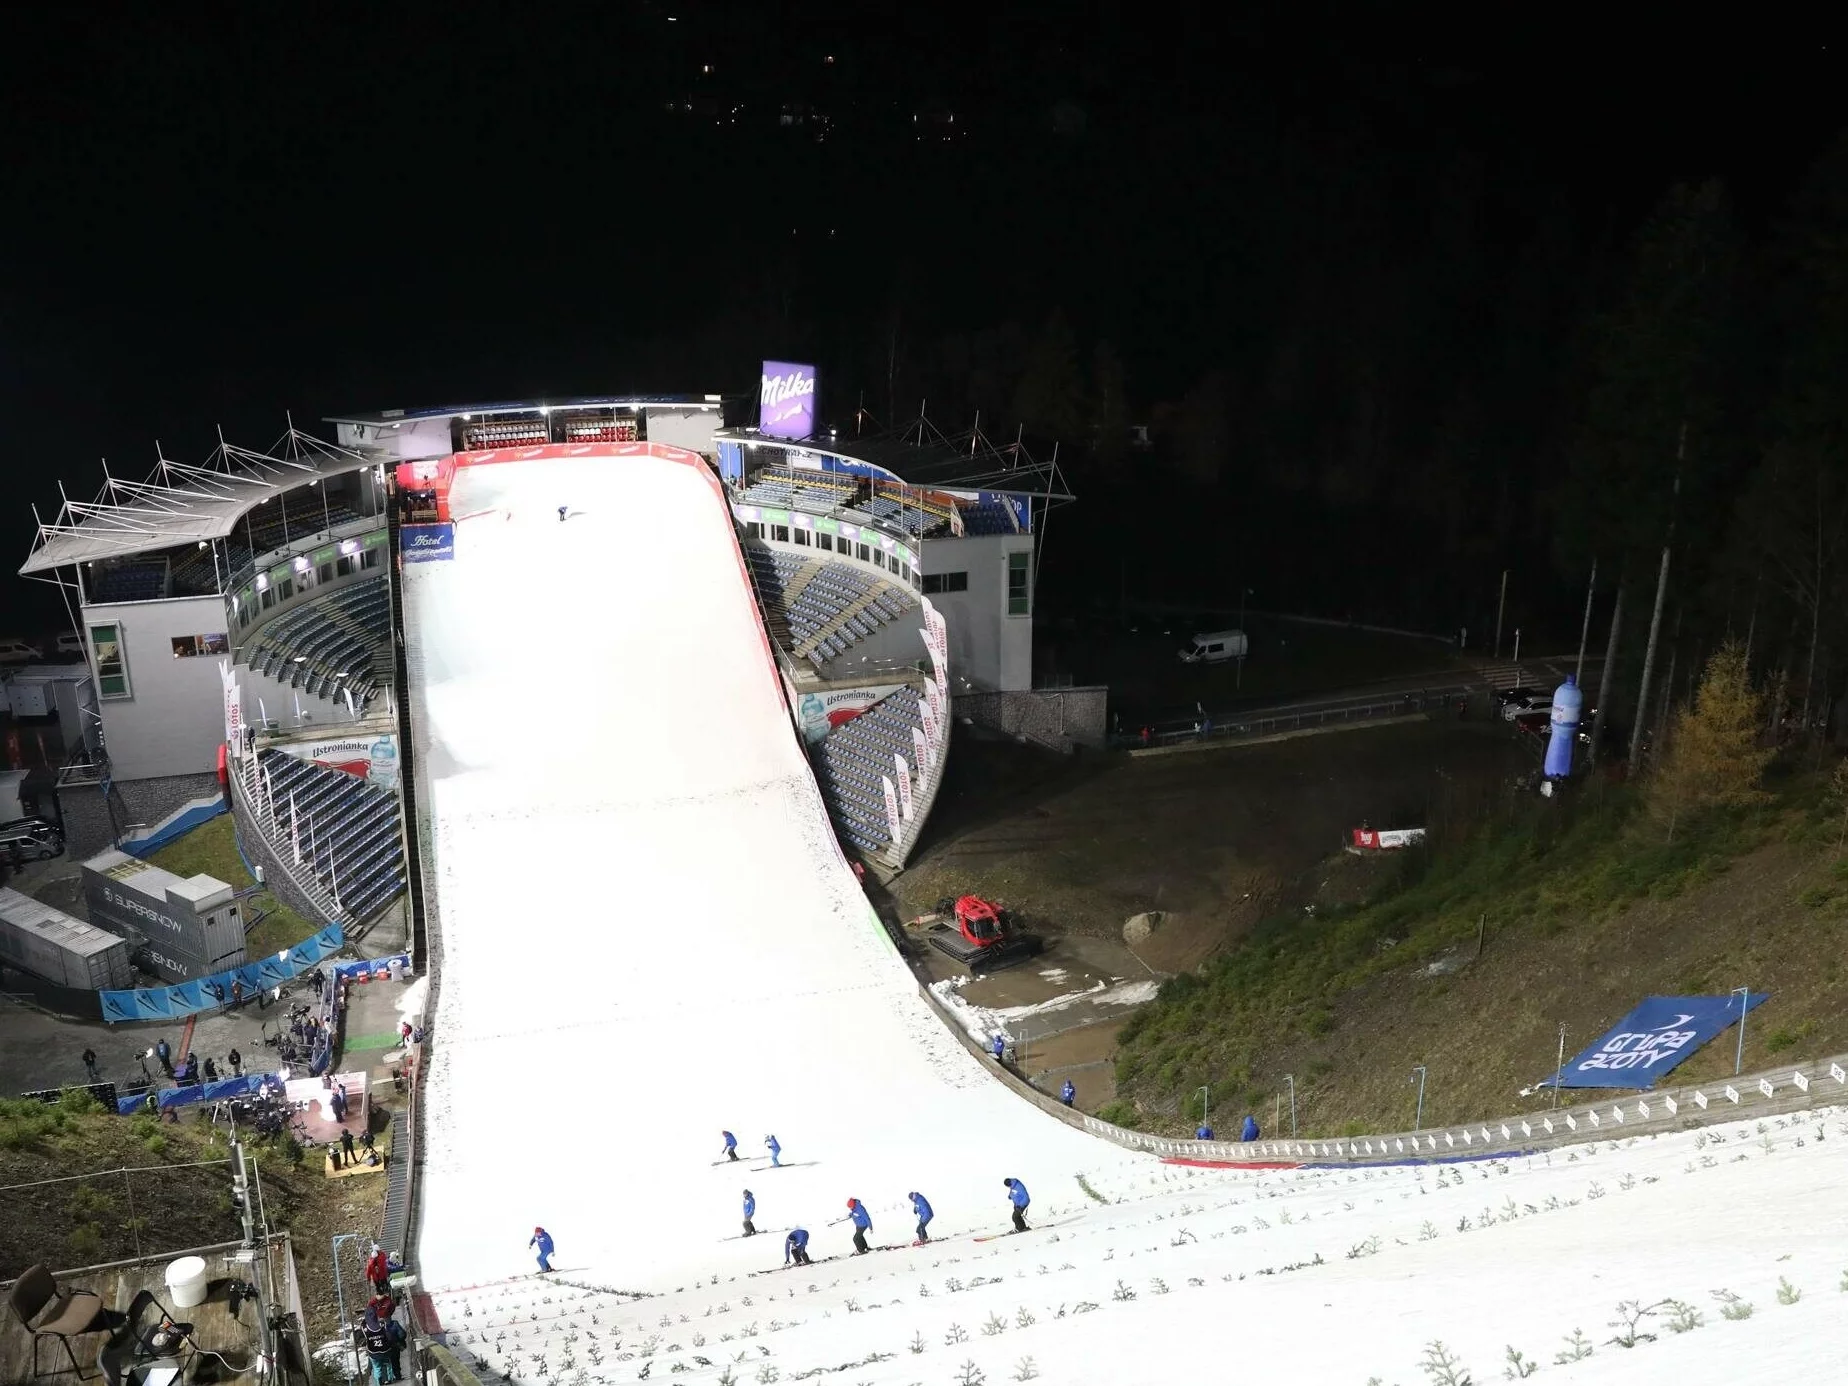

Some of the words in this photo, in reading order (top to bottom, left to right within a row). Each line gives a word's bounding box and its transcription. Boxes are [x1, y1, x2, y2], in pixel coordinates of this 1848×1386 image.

[761, 371, 814, 408] Milka
[411, 535, 444, 547] Hotel
[115, 893, 182, 933] SUPERSNOW
